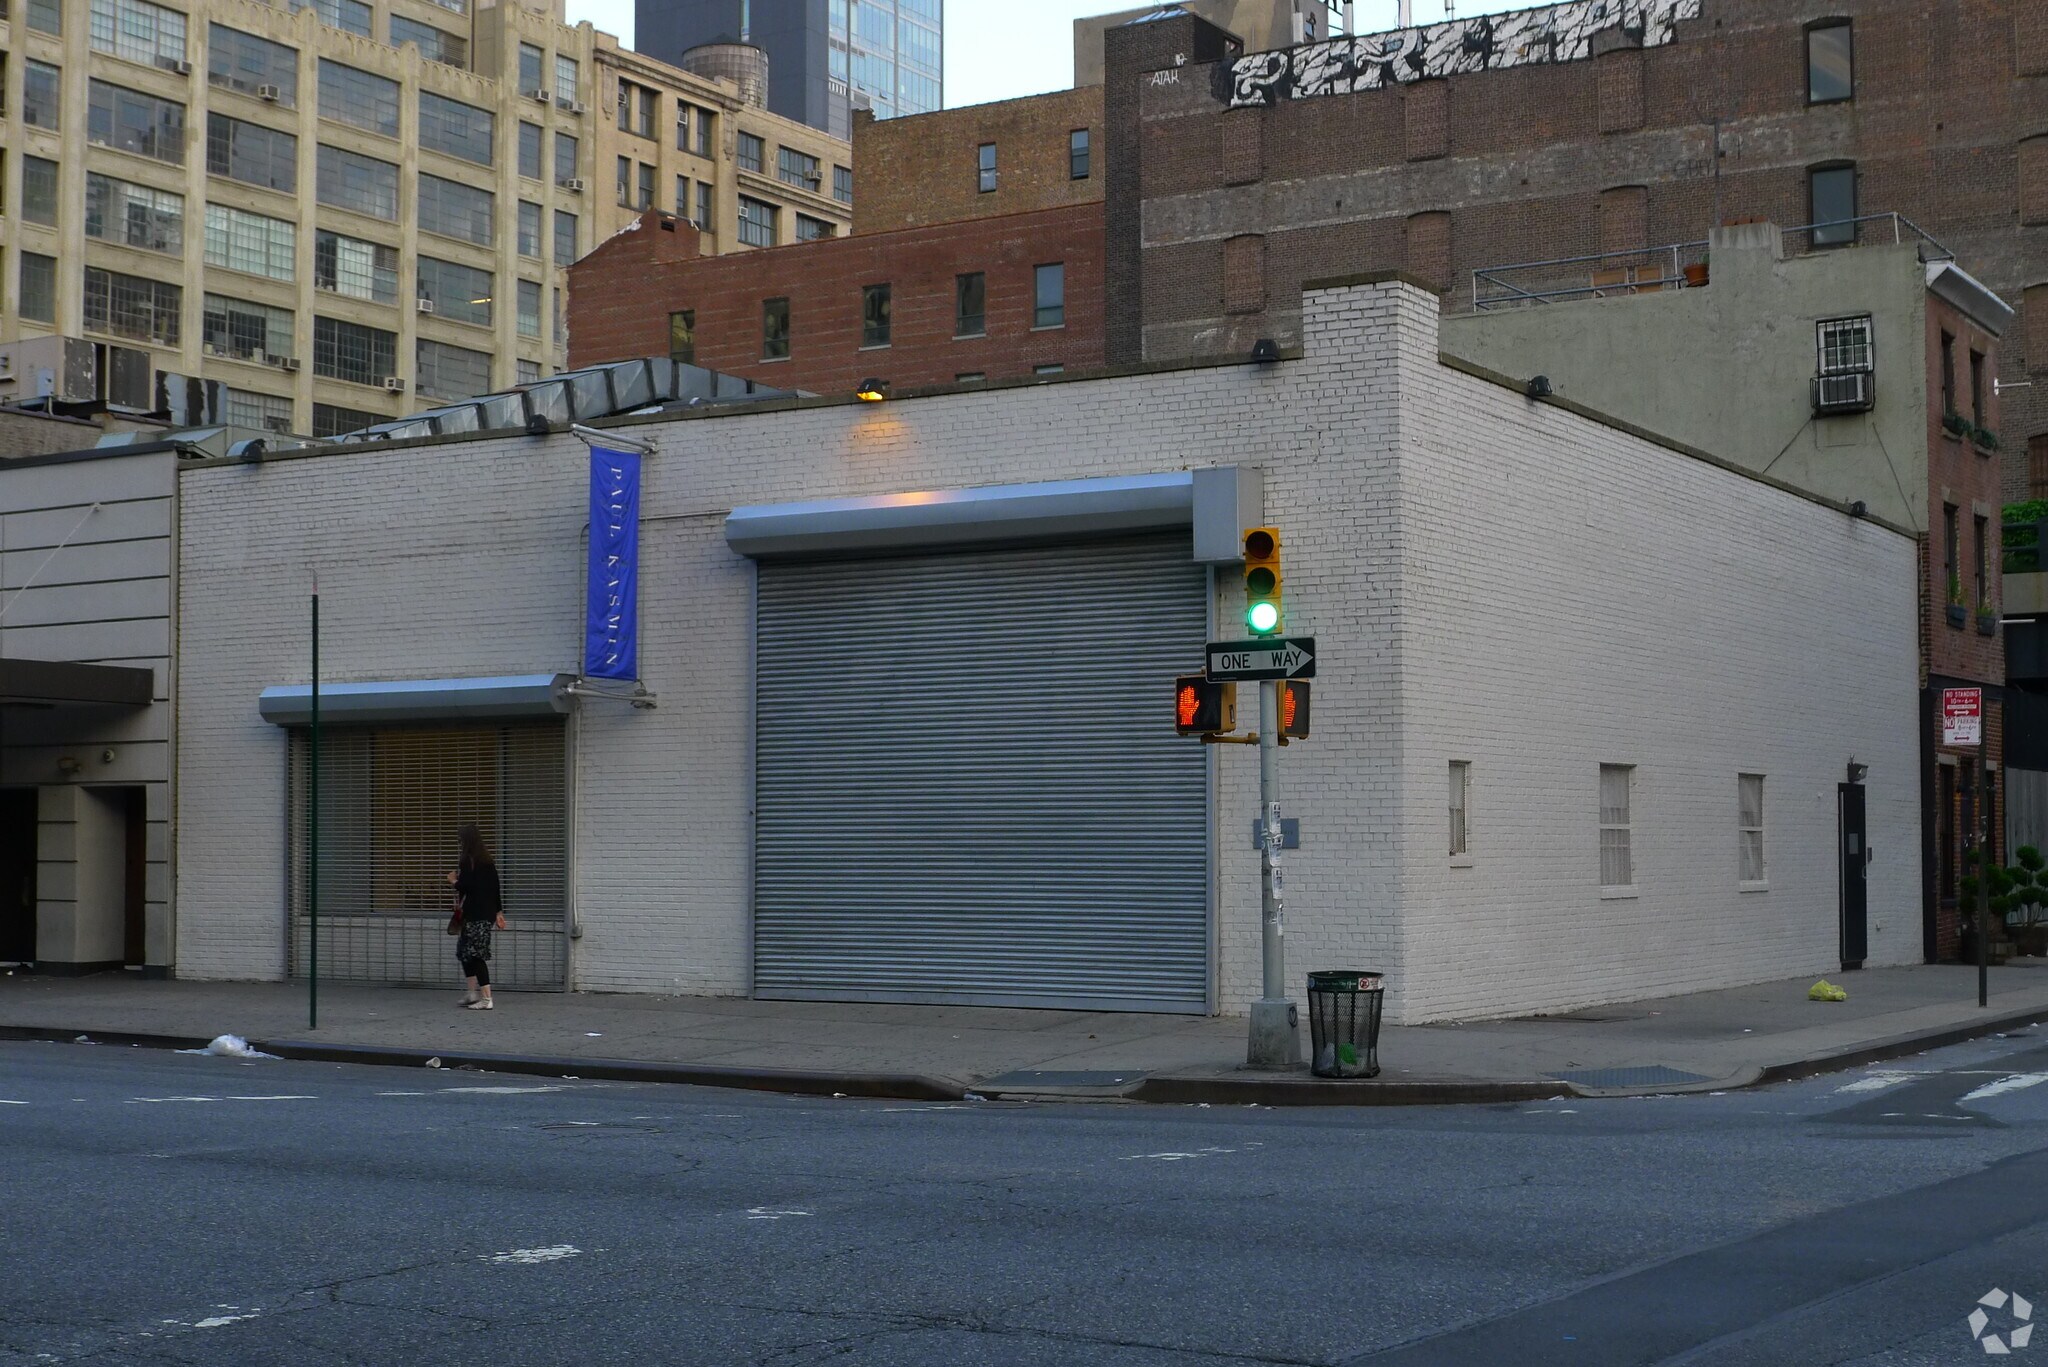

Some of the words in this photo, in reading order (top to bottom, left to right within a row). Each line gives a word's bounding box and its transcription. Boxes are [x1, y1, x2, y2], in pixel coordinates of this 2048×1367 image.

[610, 467, 623, 538] PAUL
[606, 554, 621, 666] KASMIN
[1221, 654, 1251, 669] ONE
[1271, 651, 1301, 667] WAY
[1945, 717, 1955, 728] NO
